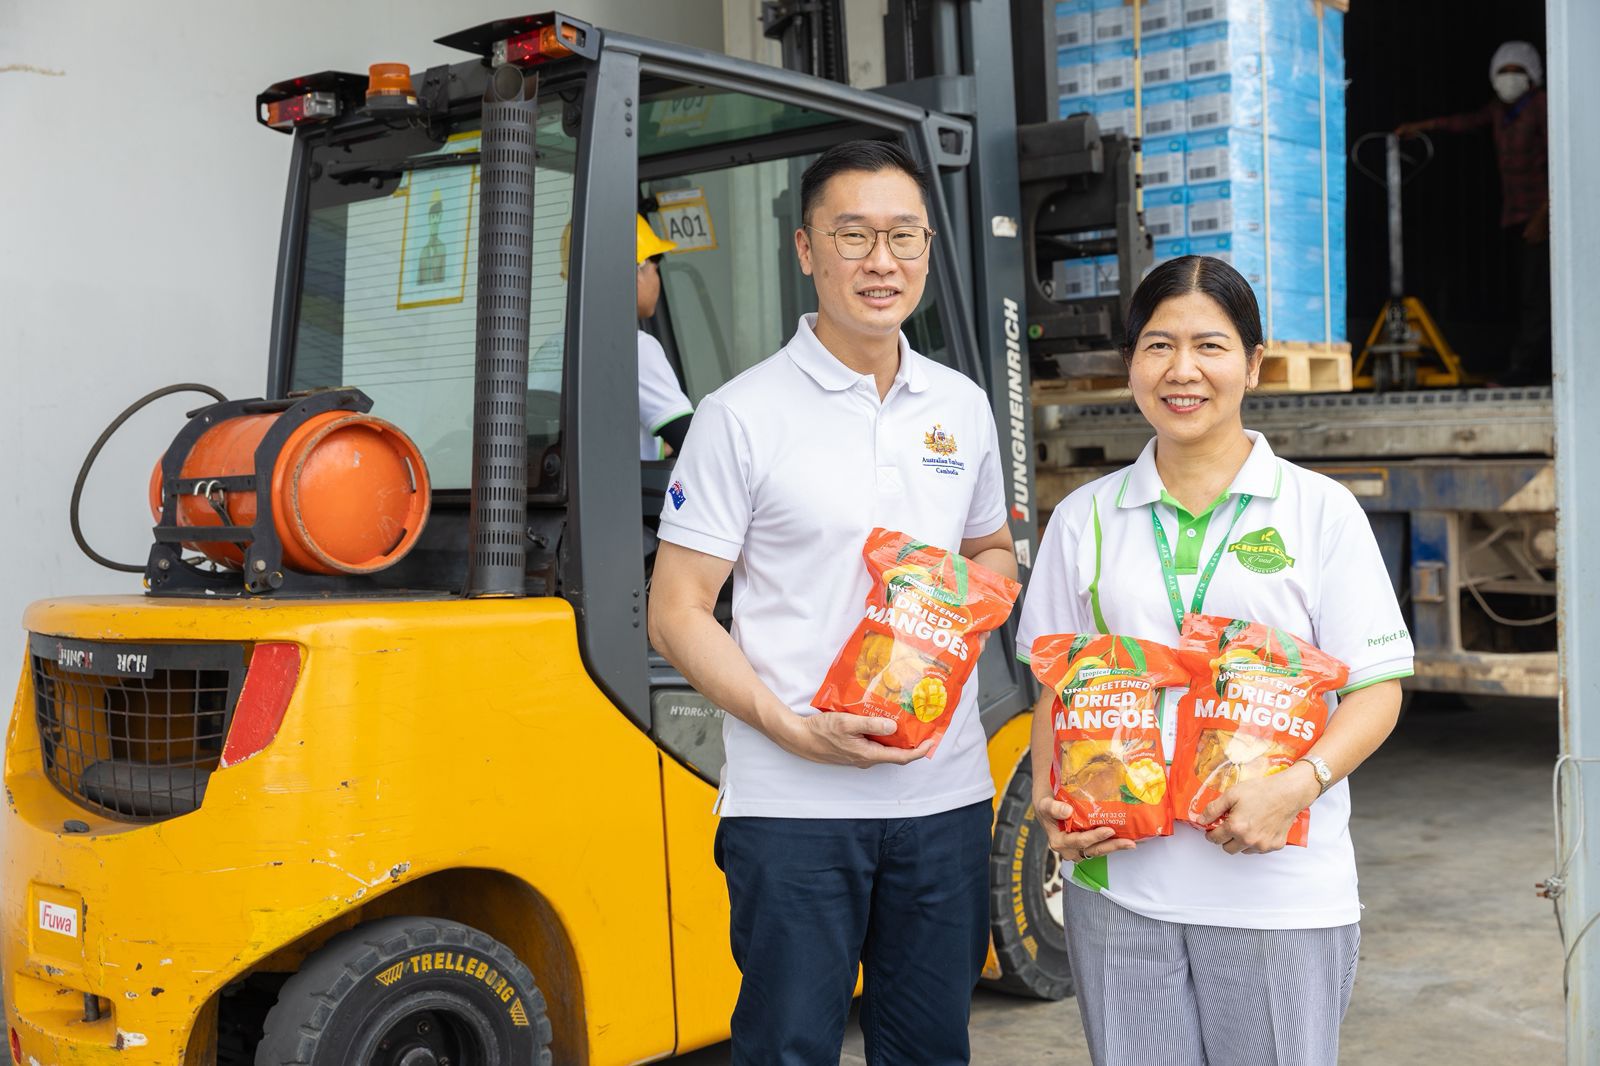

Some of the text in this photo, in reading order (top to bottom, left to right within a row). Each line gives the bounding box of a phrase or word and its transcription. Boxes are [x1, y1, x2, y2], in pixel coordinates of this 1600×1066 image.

[670, 214, 707, 240] A01
[1003, 298, 1030, 523] JUNGHEINRICH
[888, 583, 969, 625] UNSWEETENED
[895, 595, 953, 630] DRIED
[864, 605, 969, 662] MANGOES
[1367, 634, 1397, 648] Perfect
[1063, 679, 1151, 695] UNSWEETENED
[1082, 670, 1110, 678] tropical
[1218, 672, 1308, 698] UNSWEETENED
[1074, 691, 1137, 708] DRIED
[1227, 683, 1293, 710] DRIED
[1194, 698, 1317, 741] MANGOES
[1011, 824, 1030, 937] TRELLEBORG
[42, 904, 72, 933] Fuwa
[410, 952, 516, 1003] TRELLEBORG
